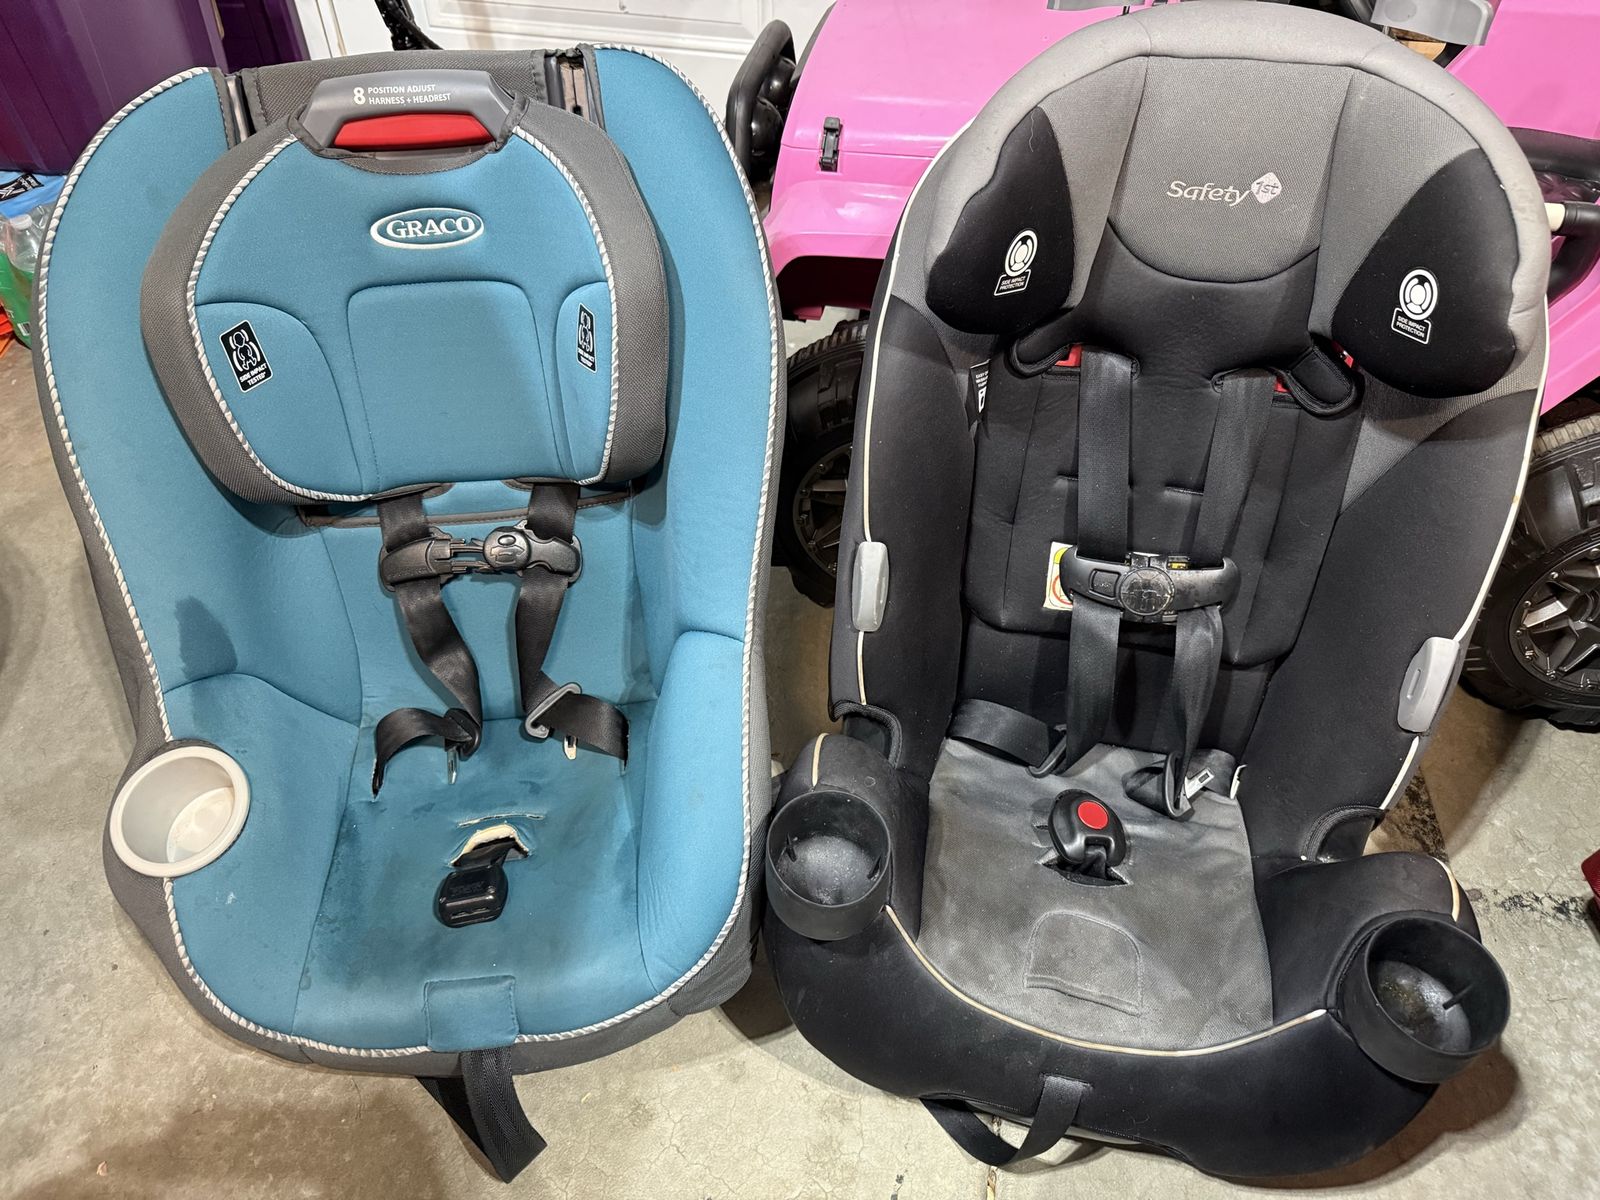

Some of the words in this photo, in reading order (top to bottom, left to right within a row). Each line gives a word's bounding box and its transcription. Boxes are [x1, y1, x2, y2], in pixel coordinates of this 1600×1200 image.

[353, 87, 366, 105] 8
[368, 86, 405, 94] POSITION
[407, 84, 436, 93] ADJUST
[368, 96, 405, 105] HARNESS
[413, 93, 451, 104] HEADREST
[1166, 180, 1251, 207] Safety
[386, 216, 475, 238] GRACO
[1396, 321, 1425, 338] PROTECTION
[1397, 315, 1408, 325] SIDE
[1408, 320, 1426, 331] IMPACT
[239, 372, 251, 383] SIDE
[250, 363, 267, 376] IMPACT
